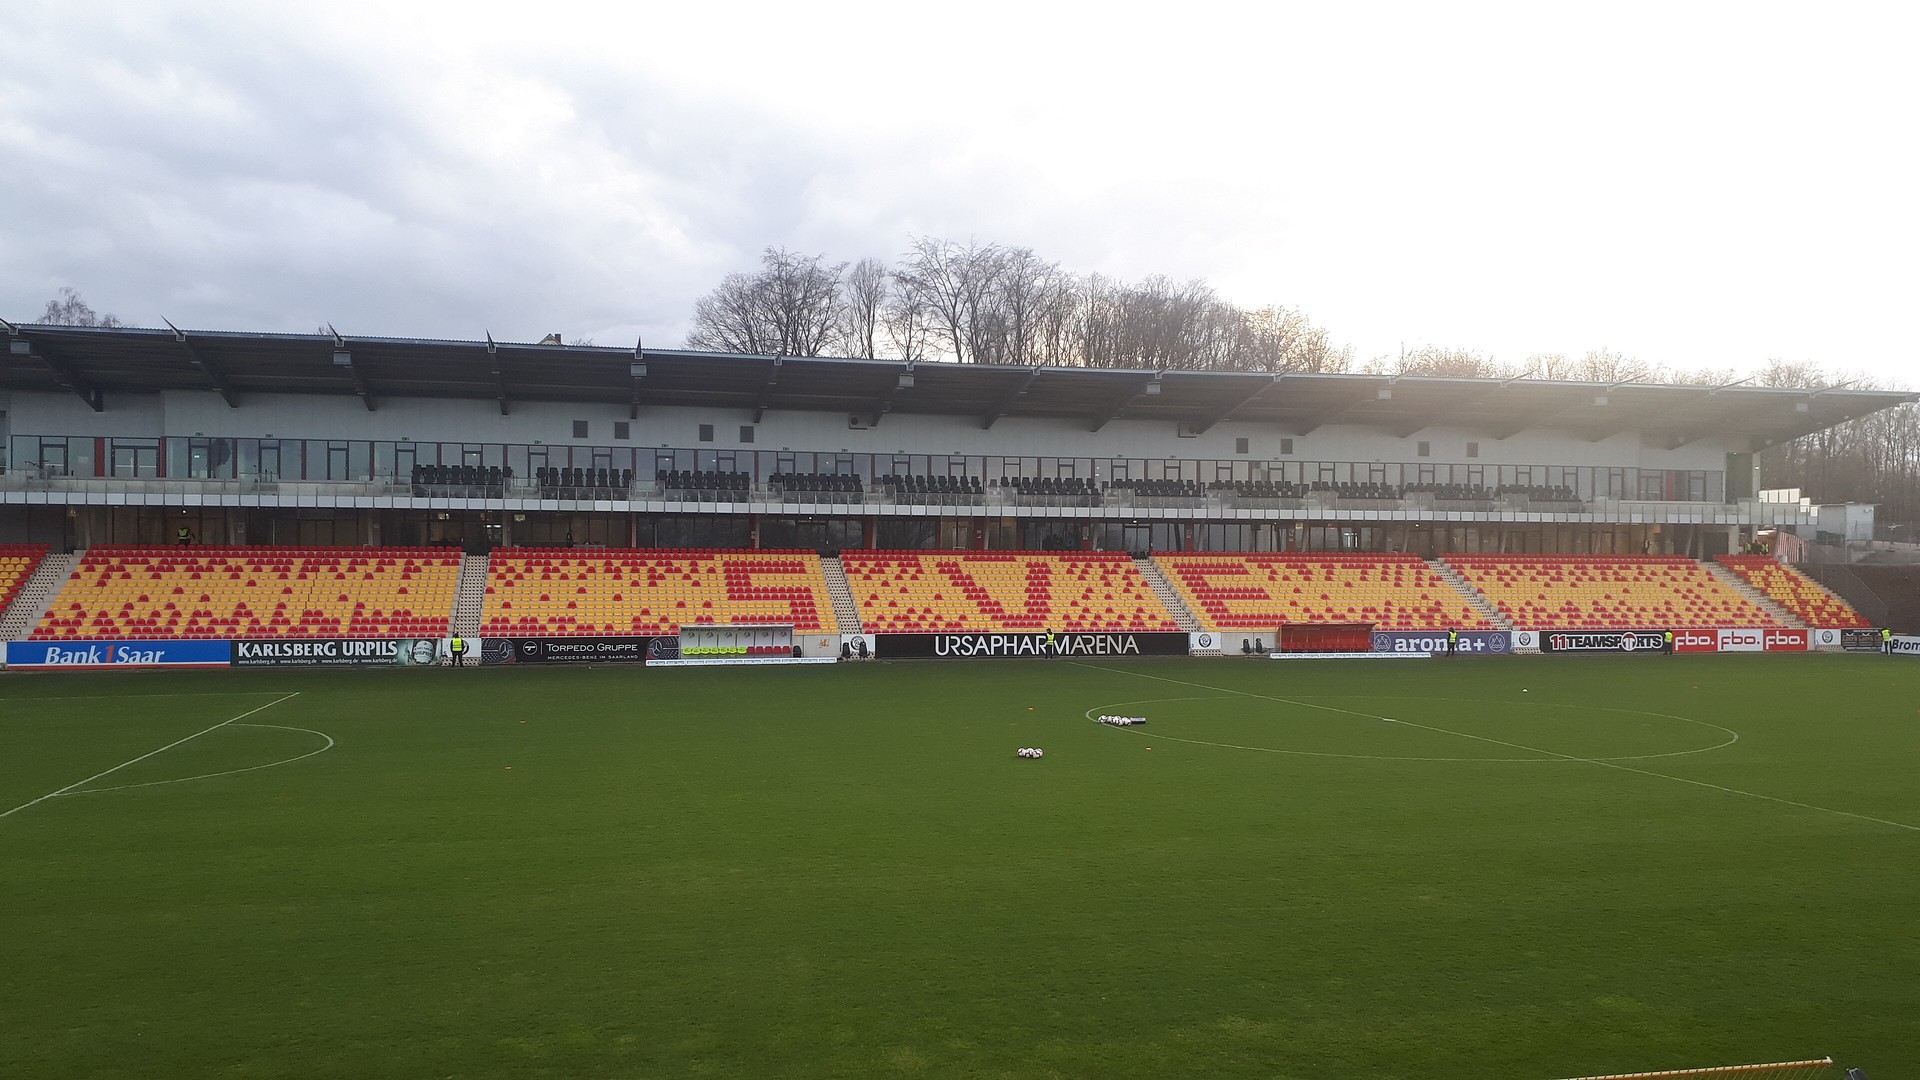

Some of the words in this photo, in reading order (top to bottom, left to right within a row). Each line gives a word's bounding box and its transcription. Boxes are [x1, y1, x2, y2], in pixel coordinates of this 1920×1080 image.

[45, 645, 101, 664] Bank
[115, 646, 165, 664] Saar
[238, 641, 337, 658] KARLSBERG
[342, 641, 398, 656] URPILS
